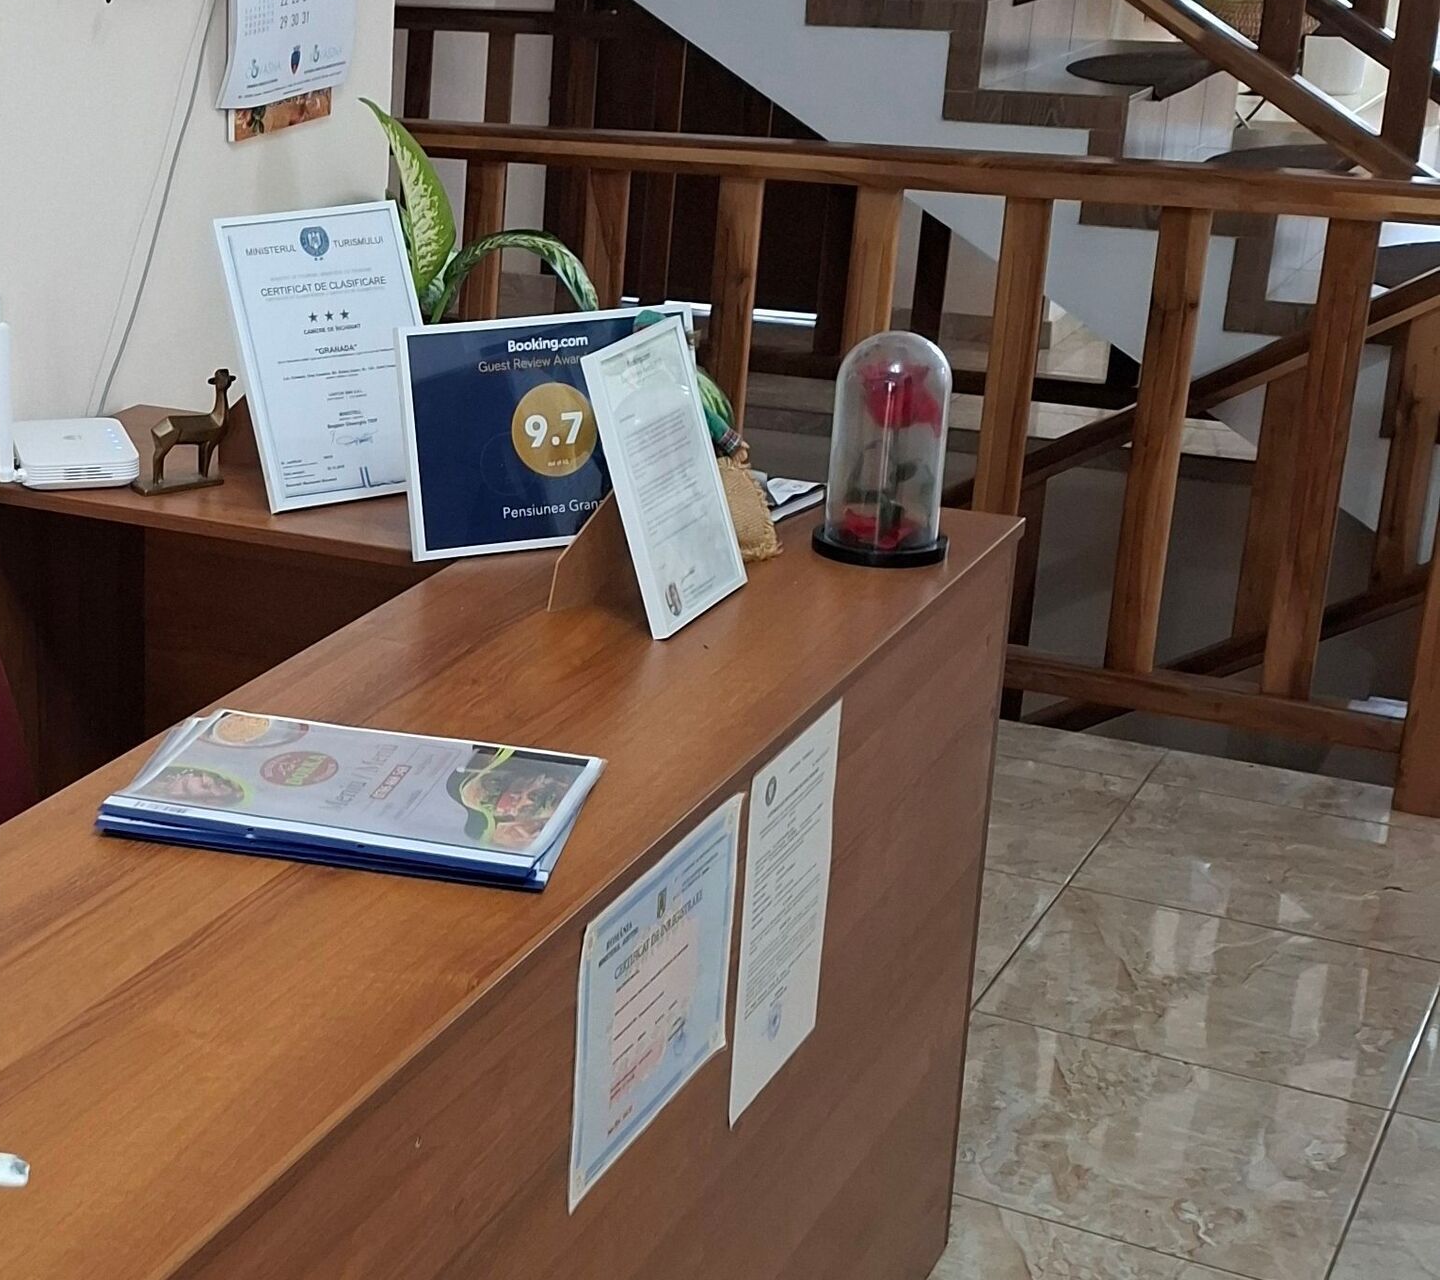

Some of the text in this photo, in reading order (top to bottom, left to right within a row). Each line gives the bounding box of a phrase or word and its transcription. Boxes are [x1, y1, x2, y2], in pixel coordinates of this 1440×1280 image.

[280, 11, 310, 30] 29 30 31
[245, 236, 384, 256] MINISTERUL TURISMULUI
[260, 283, 312, 297] CERTIFICAT
[314, 282, 327, 291] DE
[328, 276, 387, 290] CLASIFICARE
[508, 336, 588, 352] Booking.com
[478, 352, 587, 373] Guest Review Awar
[524, 411, 583, 448] 9.7
[502, 504, 566, 519] Pensiunea
[614, 937, 650, 980] CERTIFICAT
